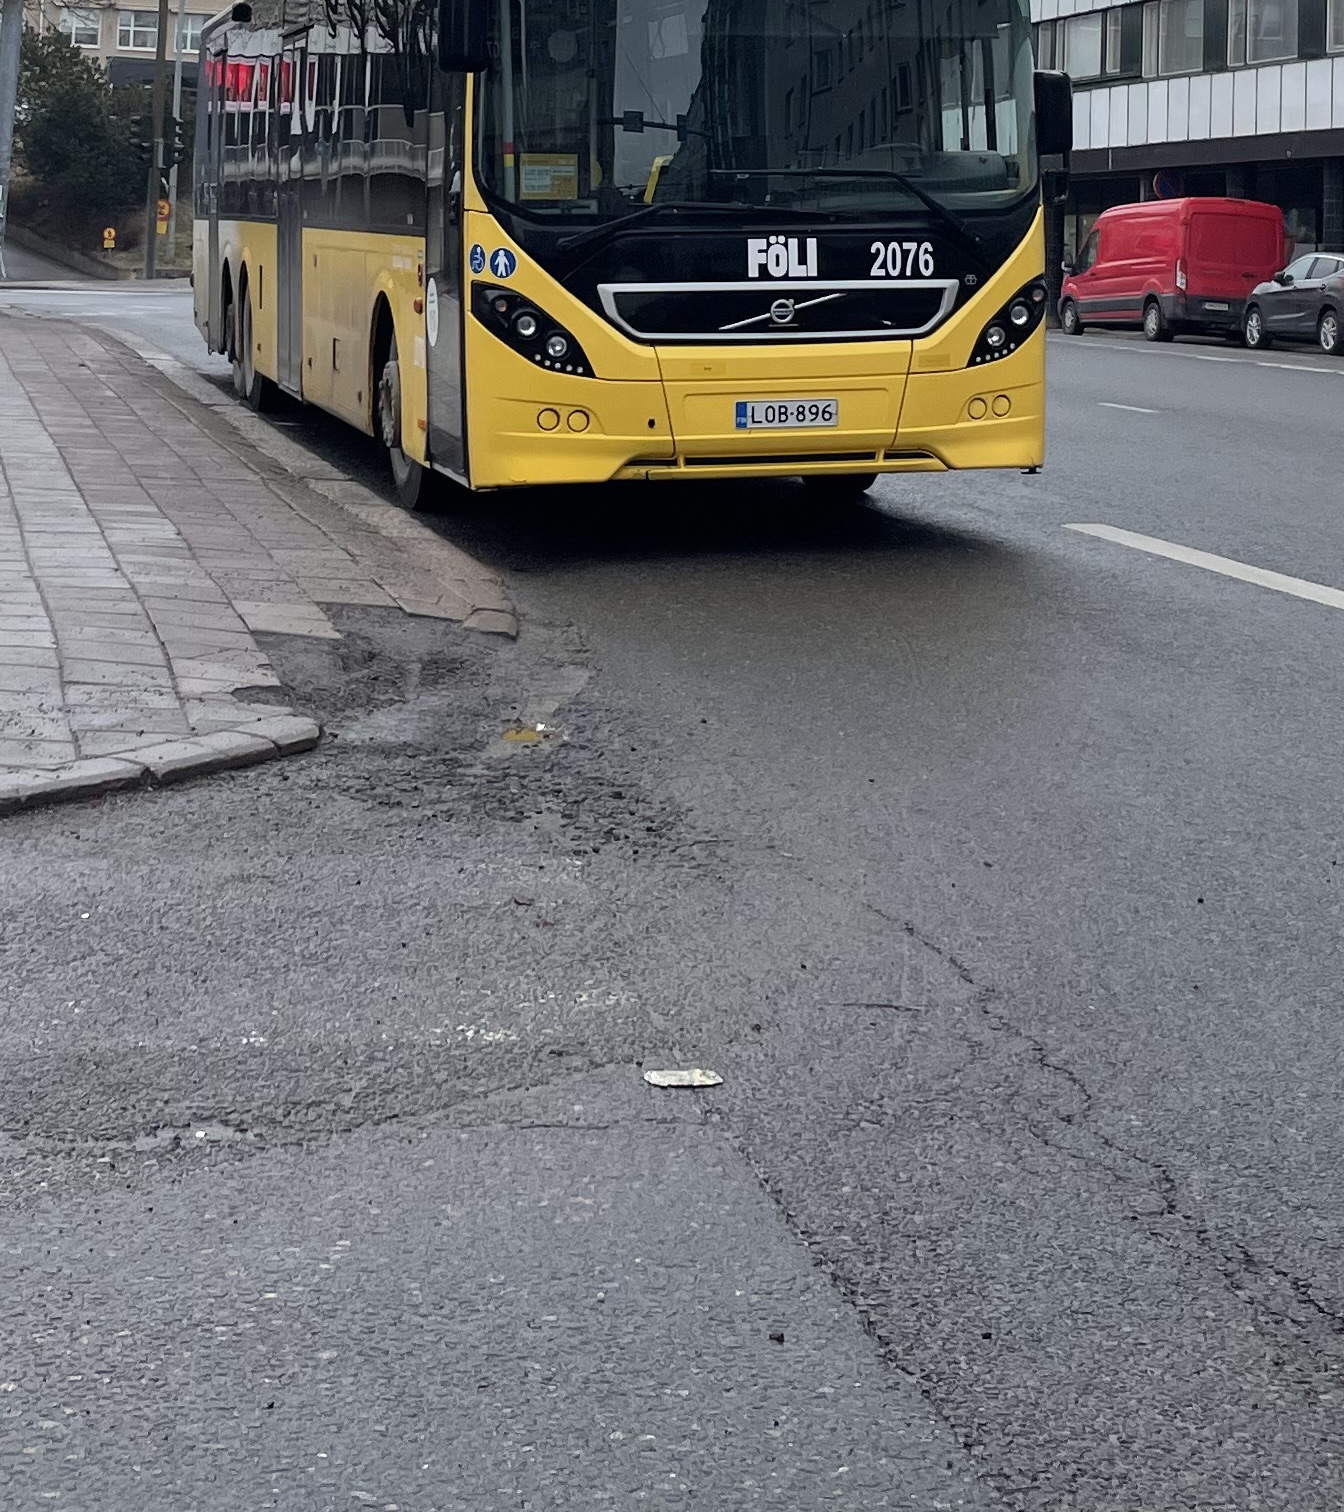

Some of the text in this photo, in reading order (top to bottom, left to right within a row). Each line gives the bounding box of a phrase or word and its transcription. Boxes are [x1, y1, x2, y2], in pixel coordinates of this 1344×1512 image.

[747, 235, 818, 278] FÖLI
[870, 241, 934, 277] 2076
[751, 403, 833, 424] LOB-896
